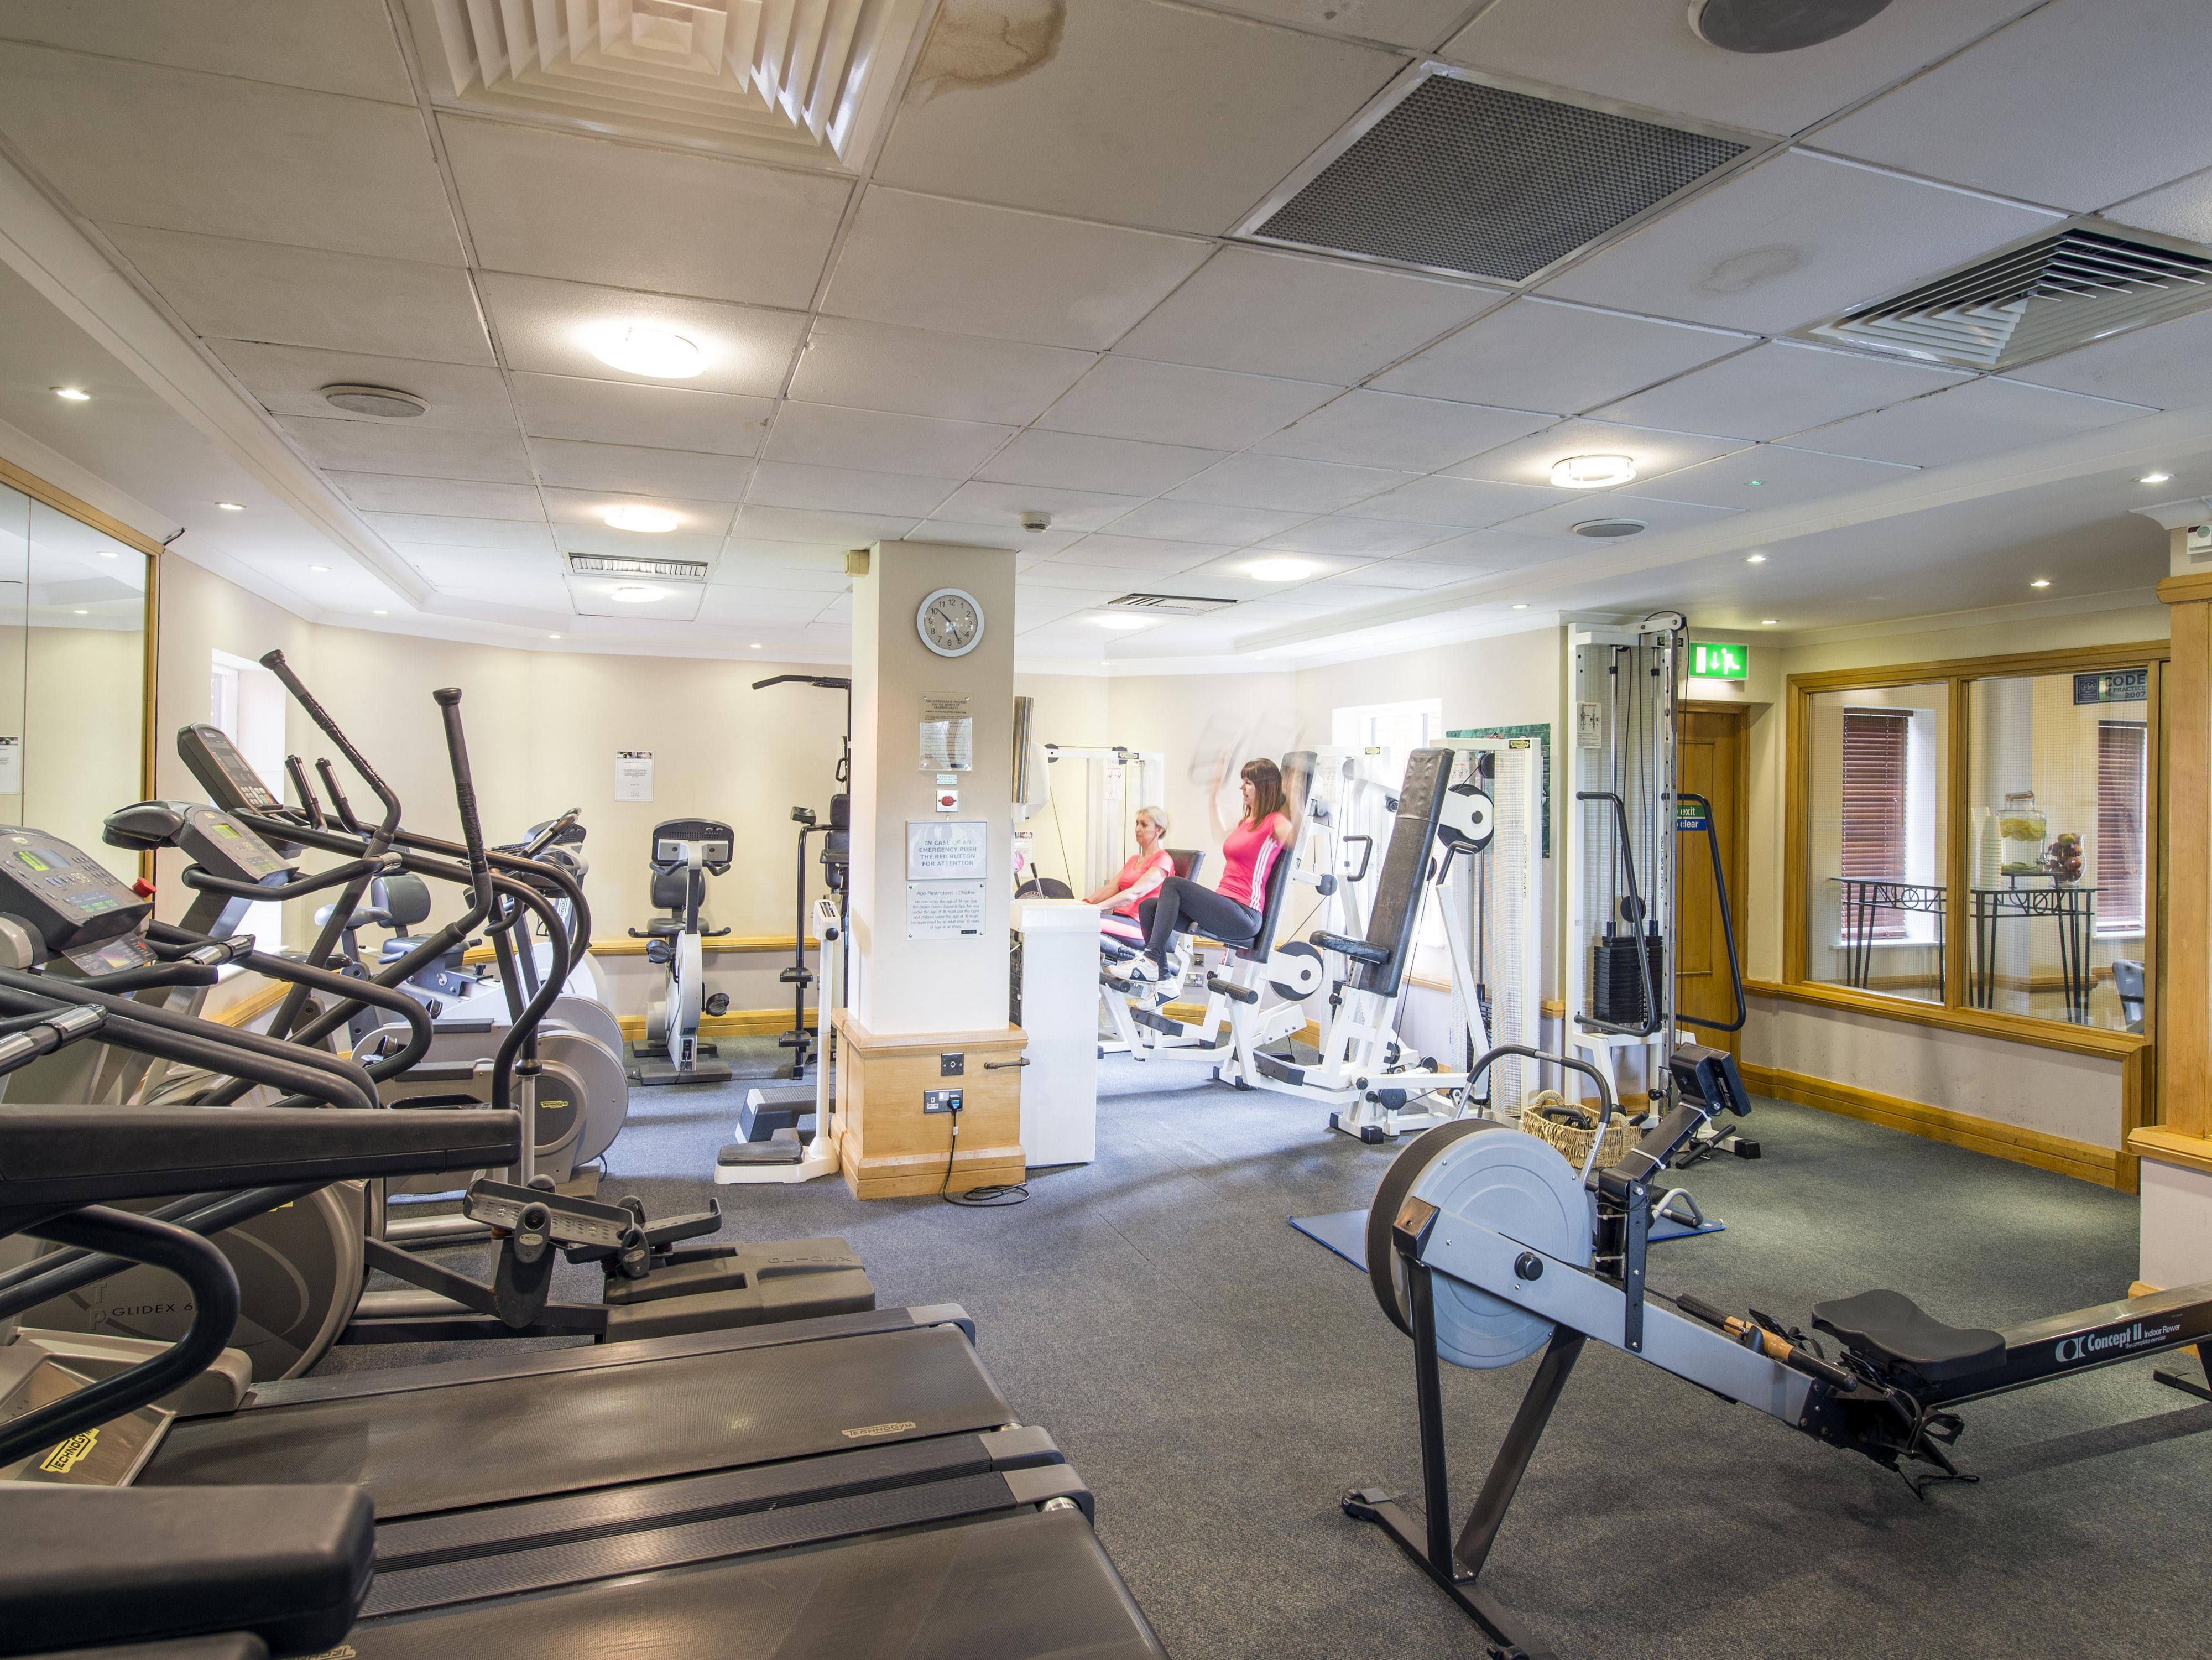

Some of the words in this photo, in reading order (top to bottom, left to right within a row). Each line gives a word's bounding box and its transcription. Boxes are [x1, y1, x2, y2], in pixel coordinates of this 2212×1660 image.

[2105, 674, 2146, 687] CODE
[1681, 806, 1695, 816] exit
[112, 1303, 175, 1316] GLIDEX
[2087, 1328, 2131, 1351] Concept
[2133, 1323, 2142, 1340] II
[2144, 1328, 2162, 1338] Indoor
[2162, 1324, 2181, 1334] Rower
[2132, 1339, 2150, 1348] complete
[844, 1423, 912, 1437] TECHNOGYM
